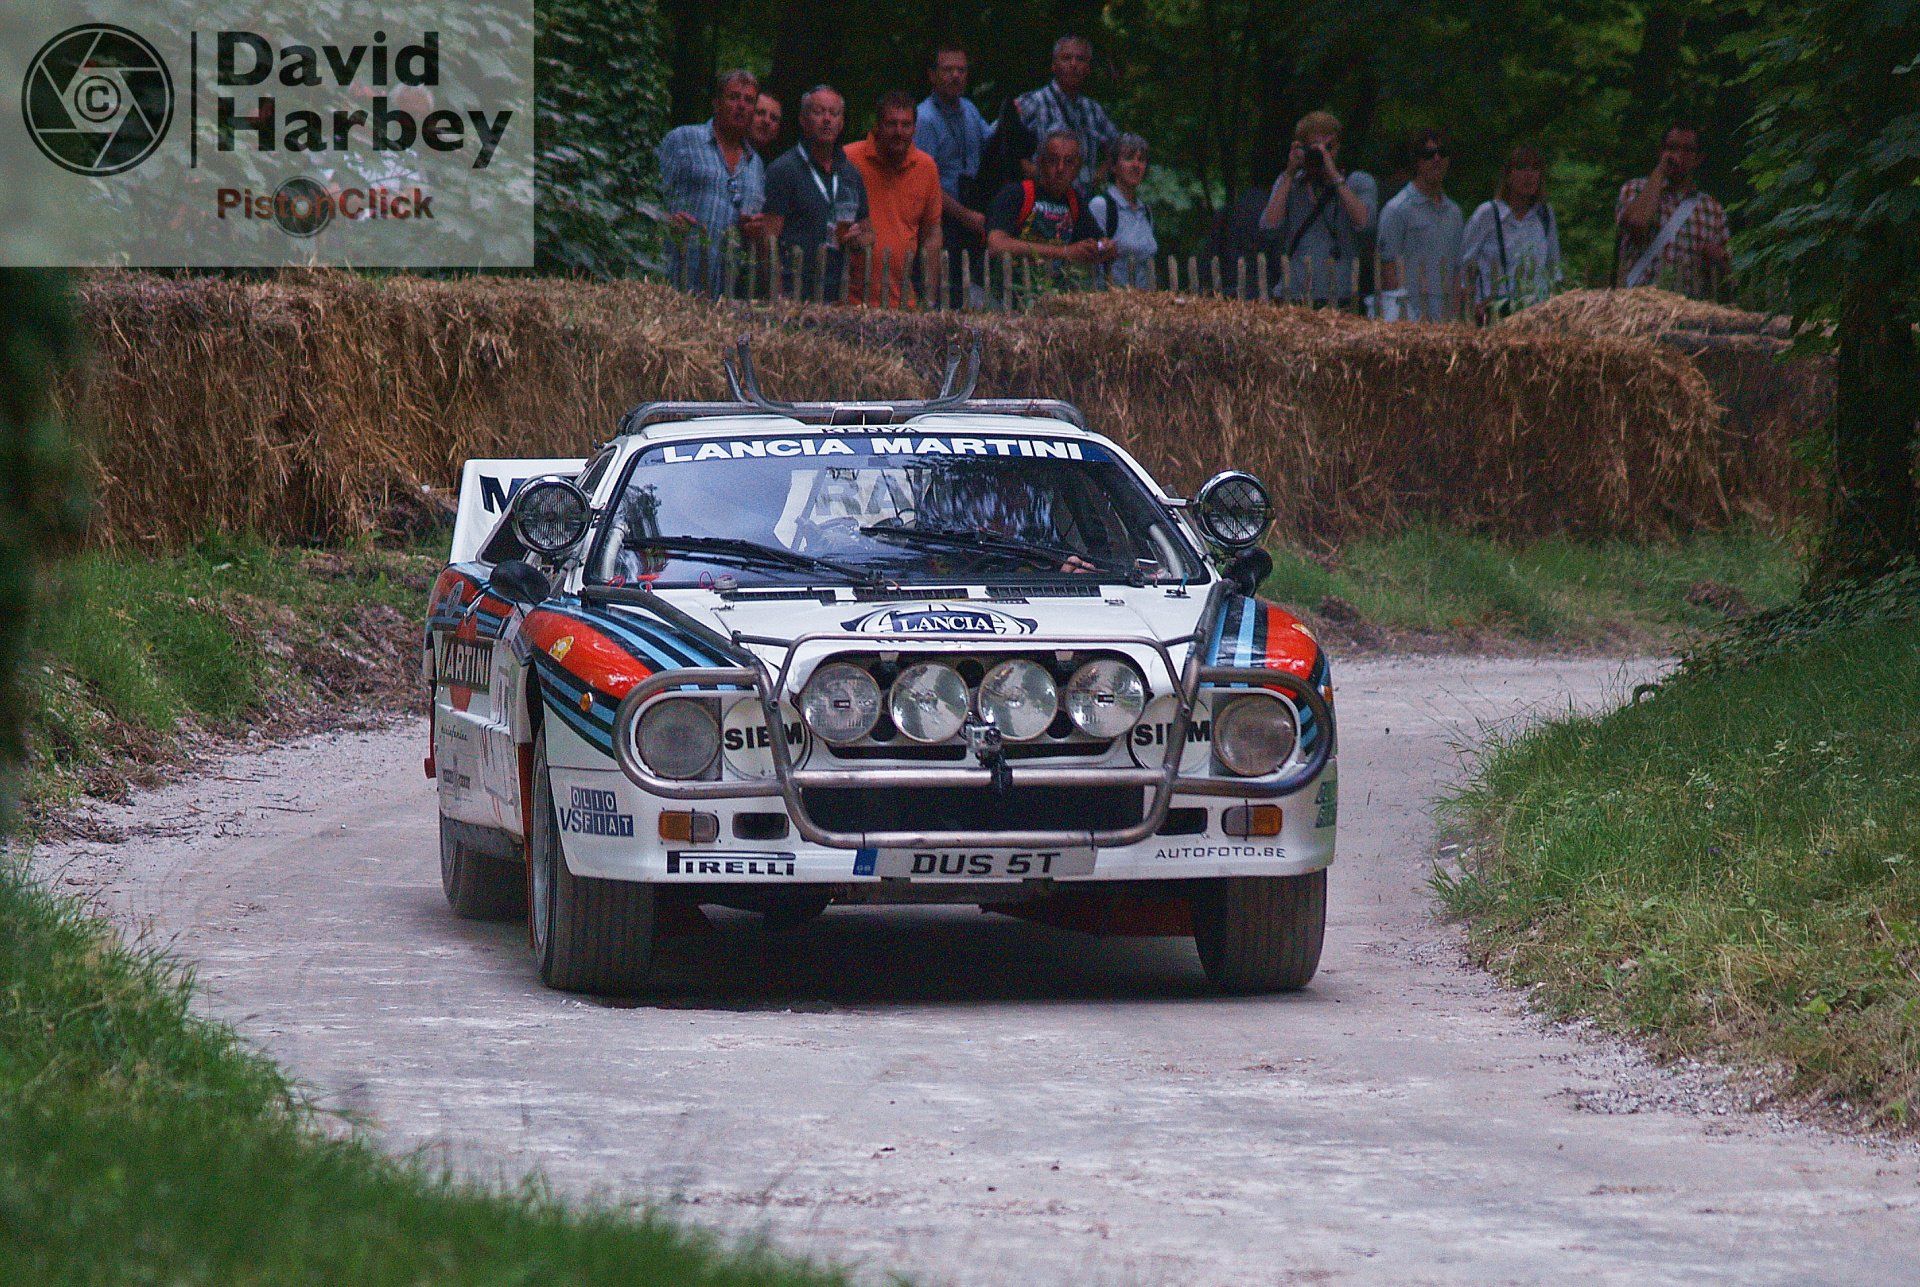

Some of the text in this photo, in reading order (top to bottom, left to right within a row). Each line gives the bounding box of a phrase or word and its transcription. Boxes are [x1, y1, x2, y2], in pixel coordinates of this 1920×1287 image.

[663, 437, 1084, 464] LANCIA MARTINI
[901, 615, 992, 633] LANCIA
[572, 788, 616, 812] OLIO
[667, 850, 796, 876] PIRELLI
[910, 852, 1061, 875] DUS 5T
[1155, 846, 1286, 859] AUTOFOTO.BE
